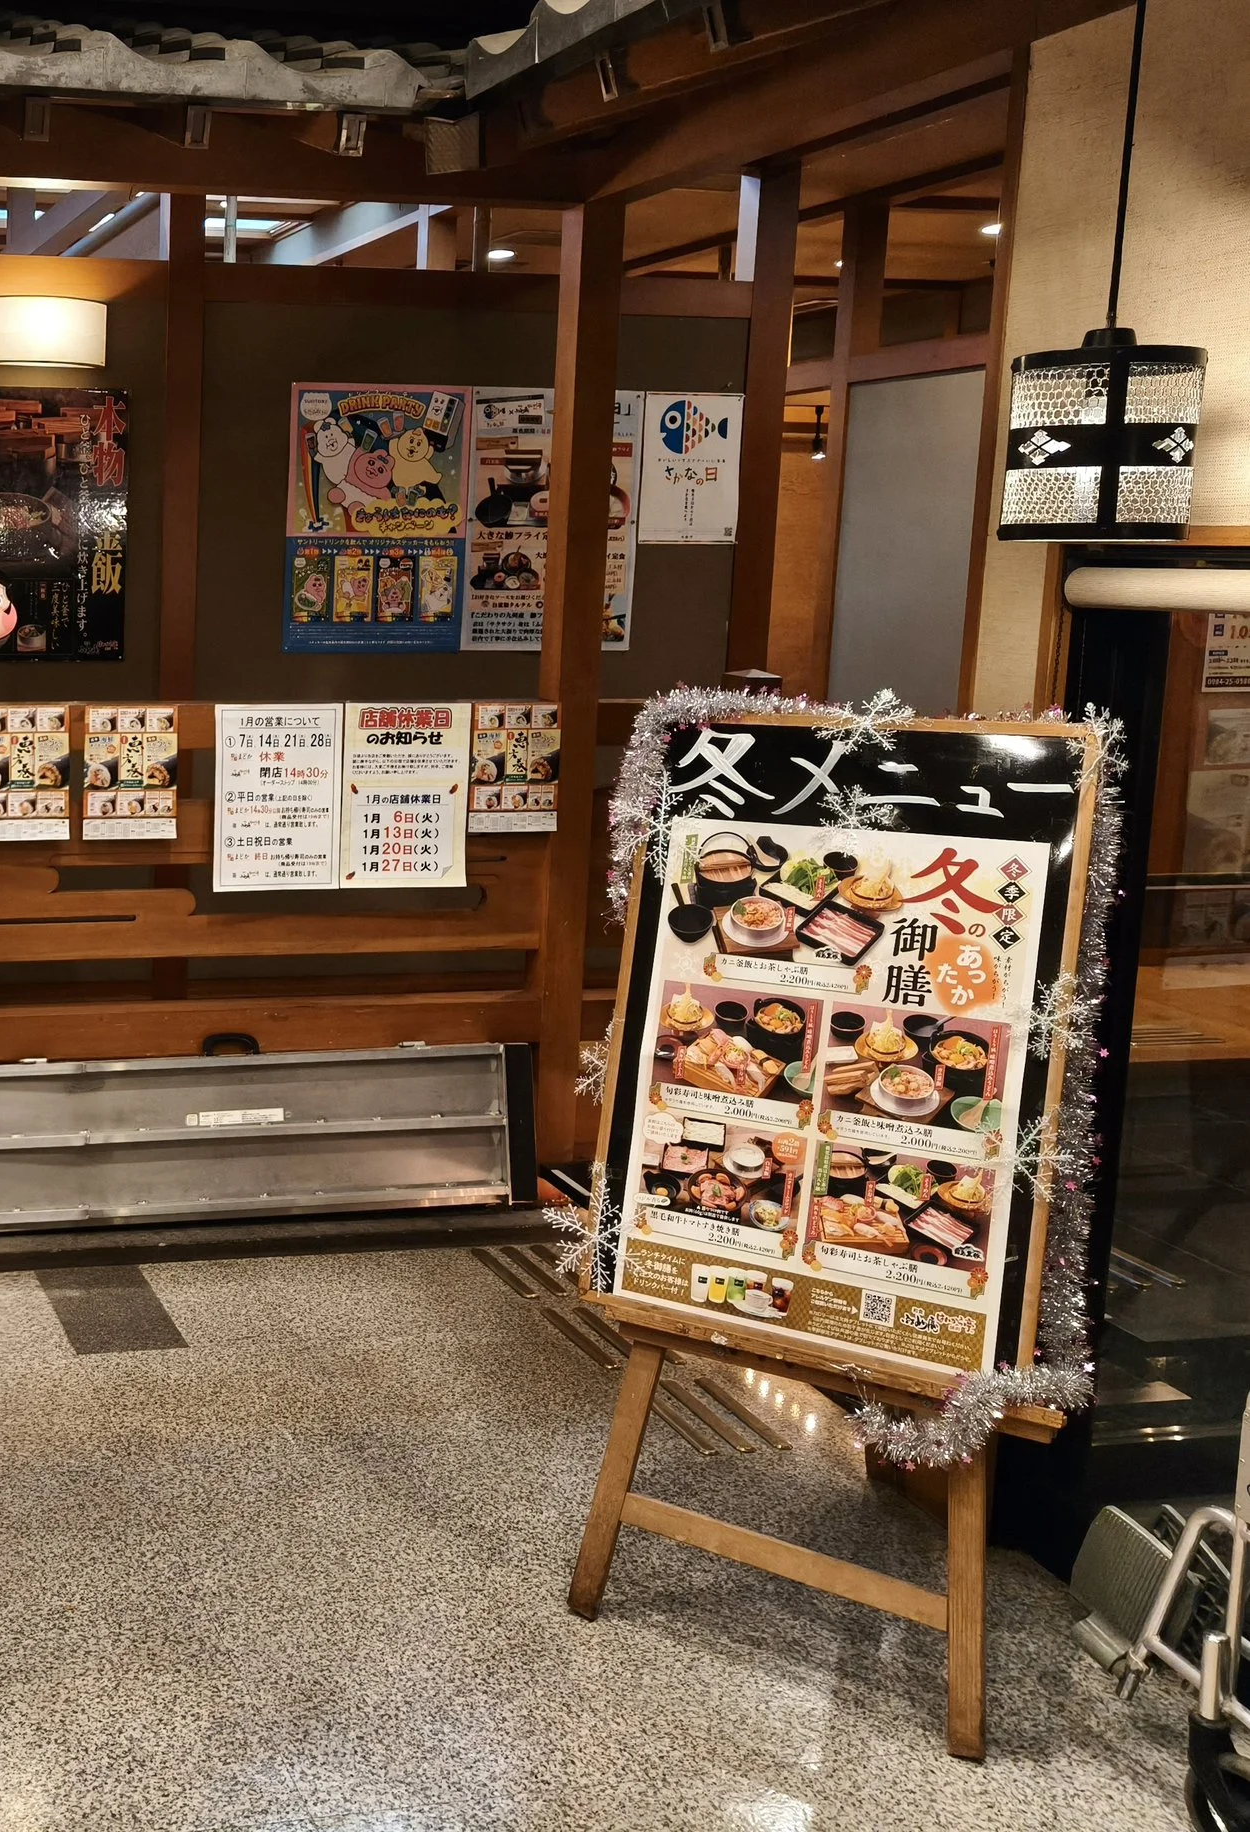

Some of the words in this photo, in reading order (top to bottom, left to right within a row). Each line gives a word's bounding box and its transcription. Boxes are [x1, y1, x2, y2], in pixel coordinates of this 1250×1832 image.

[340, 396, 380, 415] DRINK
[381, 395, 425, 417] PARTY
[92, 396, 127, 487] 本物
[664, 465, 718, 486] さかなの日
[379, 520, 434, 534] キャンペーン
[240, 716, 320, 727] 1月の営業について
[359, 706, 452, 730] 店舗休業日
[366, 731, 444, 746] のお知らせ
[259, 751, 286, 762] 休業
[284, 767, 329, 779] 14時30分
[666, 728, 1075, 820] 冬メニュー
[365, 794, 441, 805] 1月の店舗休業日
[998, 861, 1026, 943] 冬季限定
[719, 956, 810, 977] カニ釜飯とお茶しゃぶ膳
[881, 918, 939, 1008] 御膳
[936, 944, 987, 1007] あったか
[640, 1248, 686, 1265] ランチタイムに
[819, 1245, 919, 1274] 旬彩寿司とお茶しゃぶ膳
